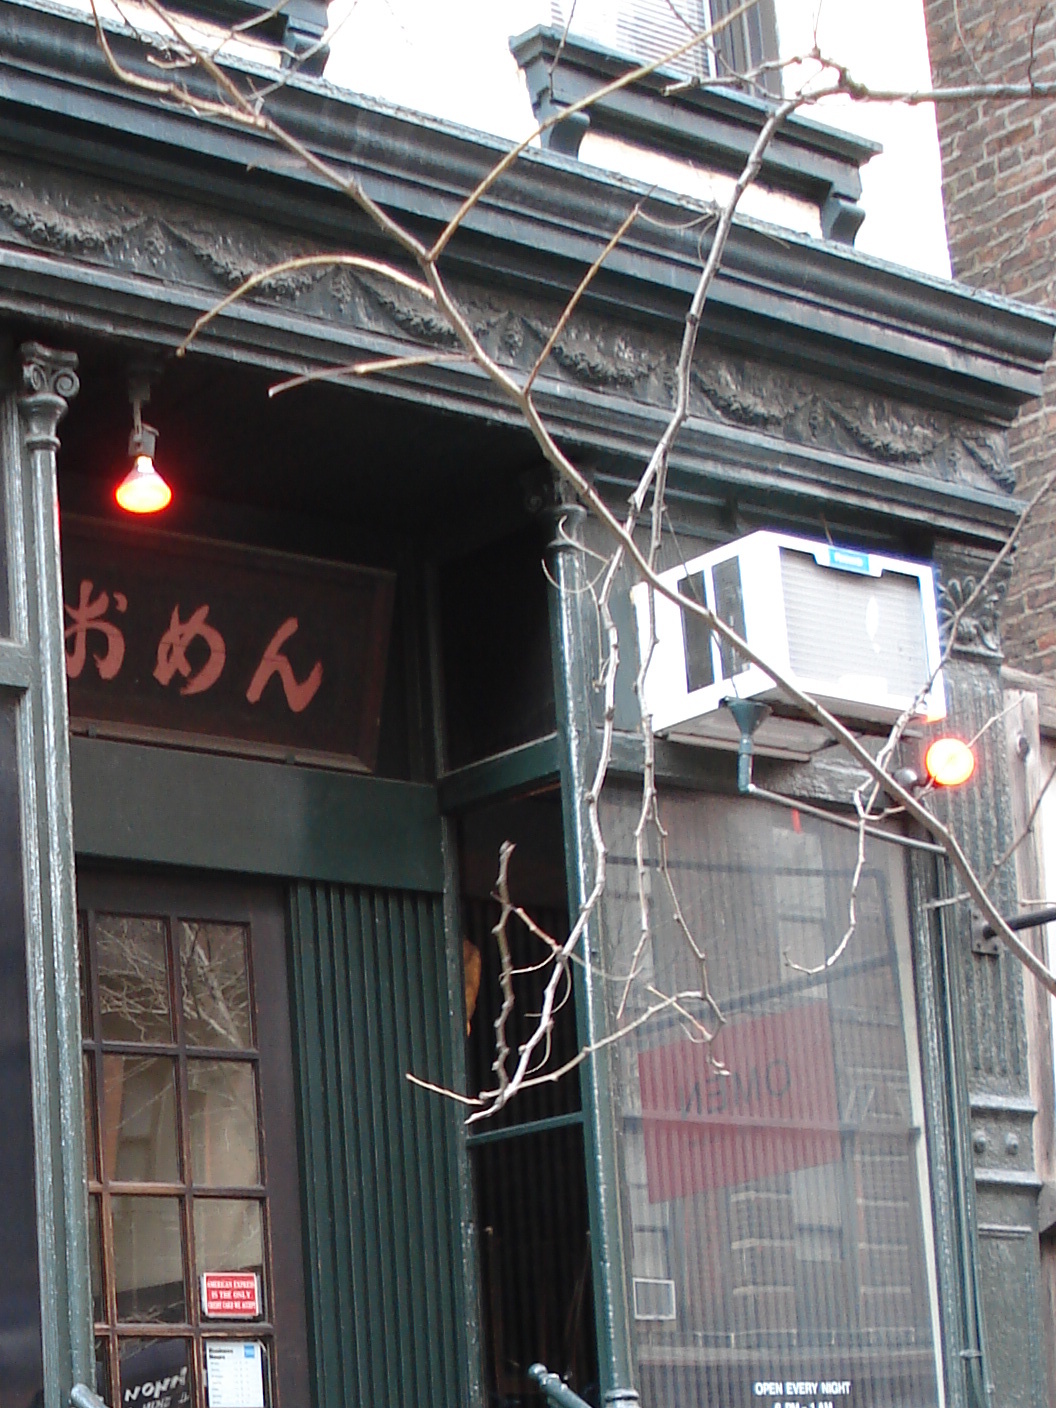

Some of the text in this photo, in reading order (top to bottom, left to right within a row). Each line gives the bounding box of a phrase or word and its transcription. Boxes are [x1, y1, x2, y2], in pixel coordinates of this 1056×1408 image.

[64, 578, 324, 713] おめん
[233, 1290, 251, 1300] ONLY
[753, 1381, 851, 1395] OPEN EVERY NIGHT
